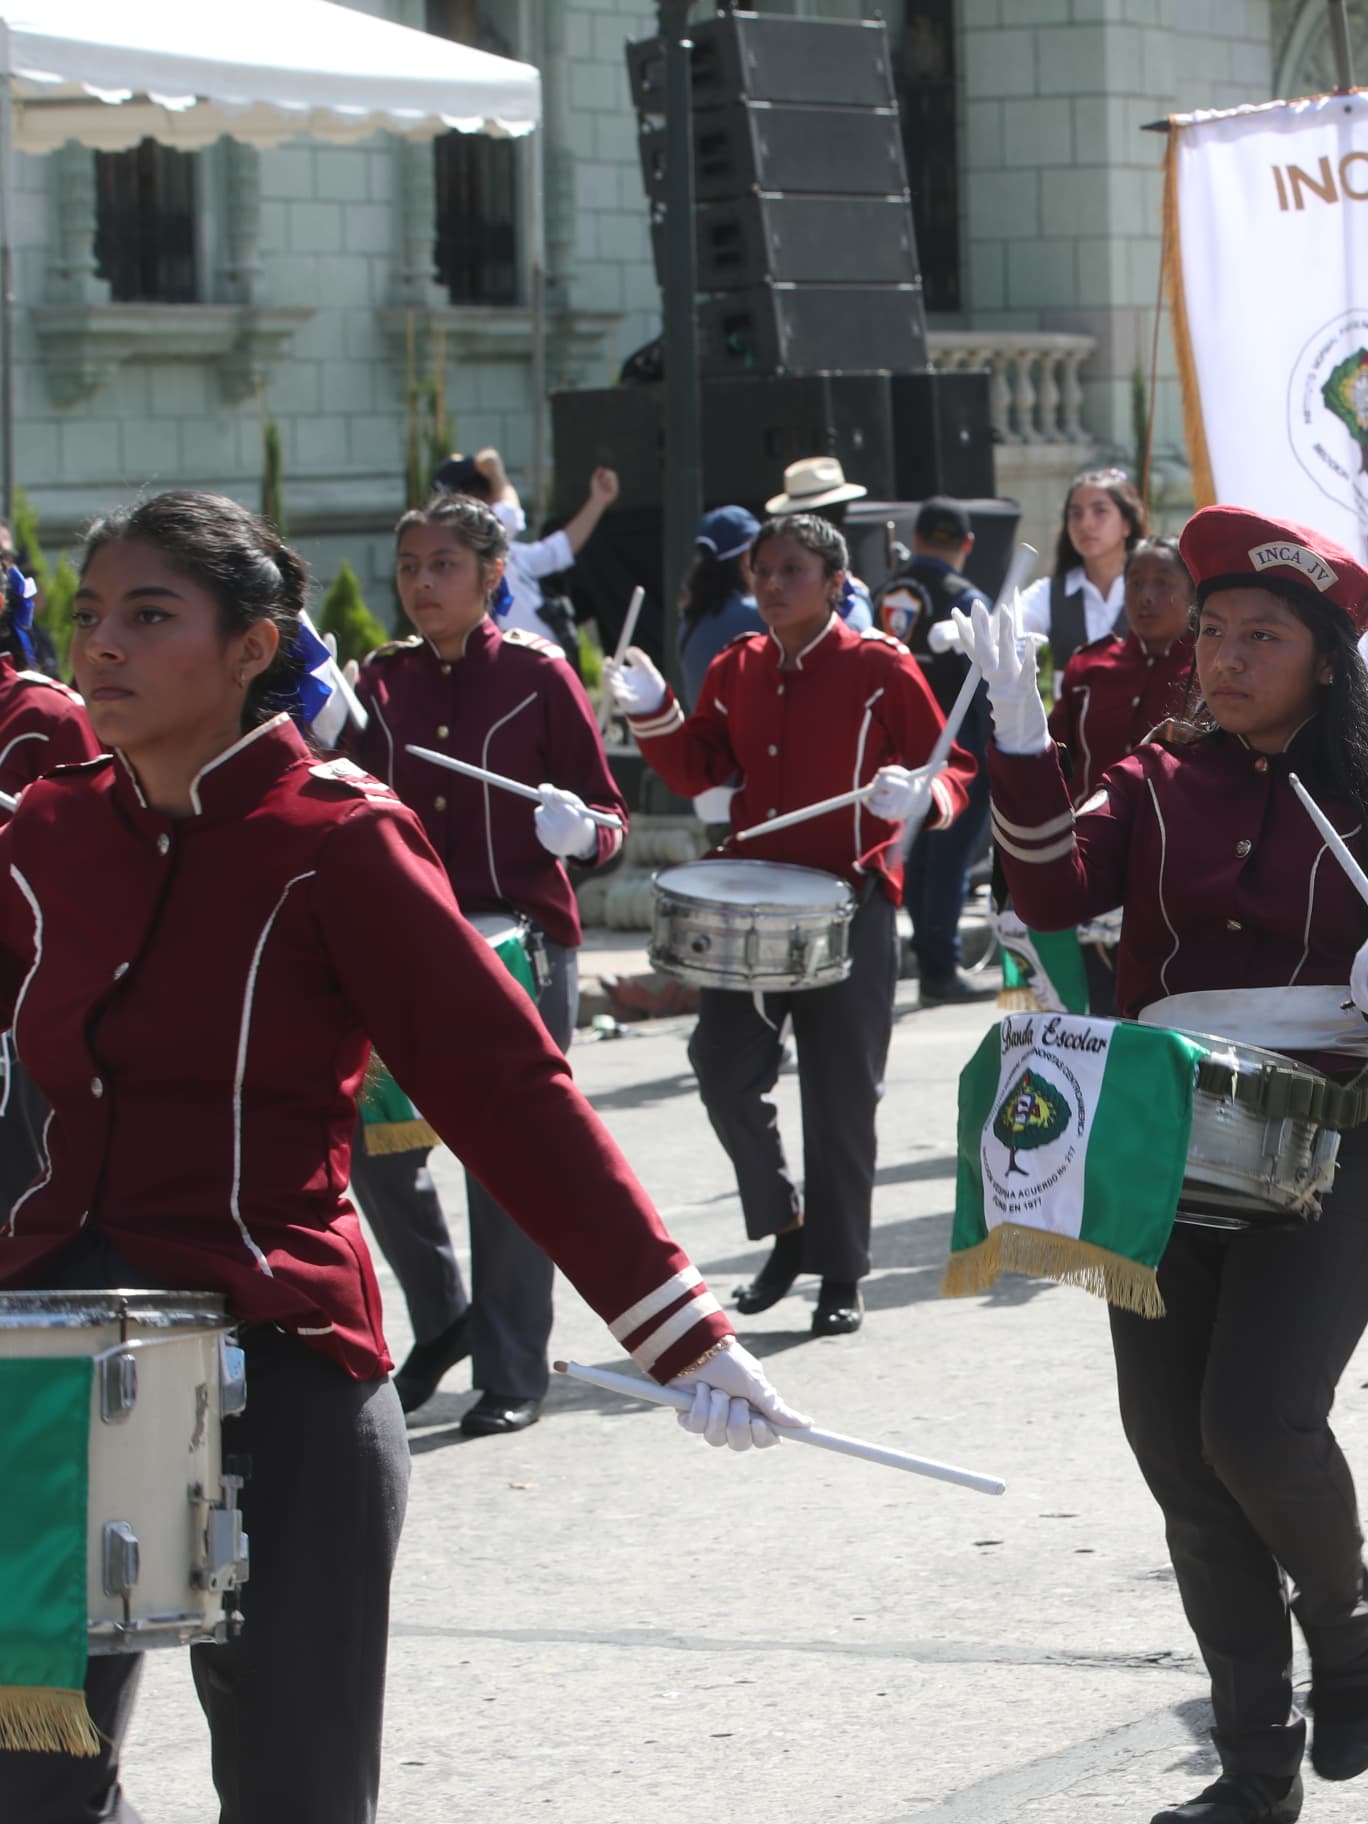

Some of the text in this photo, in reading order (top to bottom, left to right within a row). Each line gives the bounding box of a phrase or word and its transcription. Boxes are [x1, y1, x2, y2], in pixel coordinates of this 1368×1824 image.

[1256, 547, 1329, 581] INCA JV
[1002, 1016, 1108, 1055] Banda Escolar
[1018, 1173, 1059, 1199] ACUERDO
[1065, 1145, 1077, 1164] 217
[1009, 1203, 1021, 1213] EN
[1024, 1197, 1042, 1210] 1977
